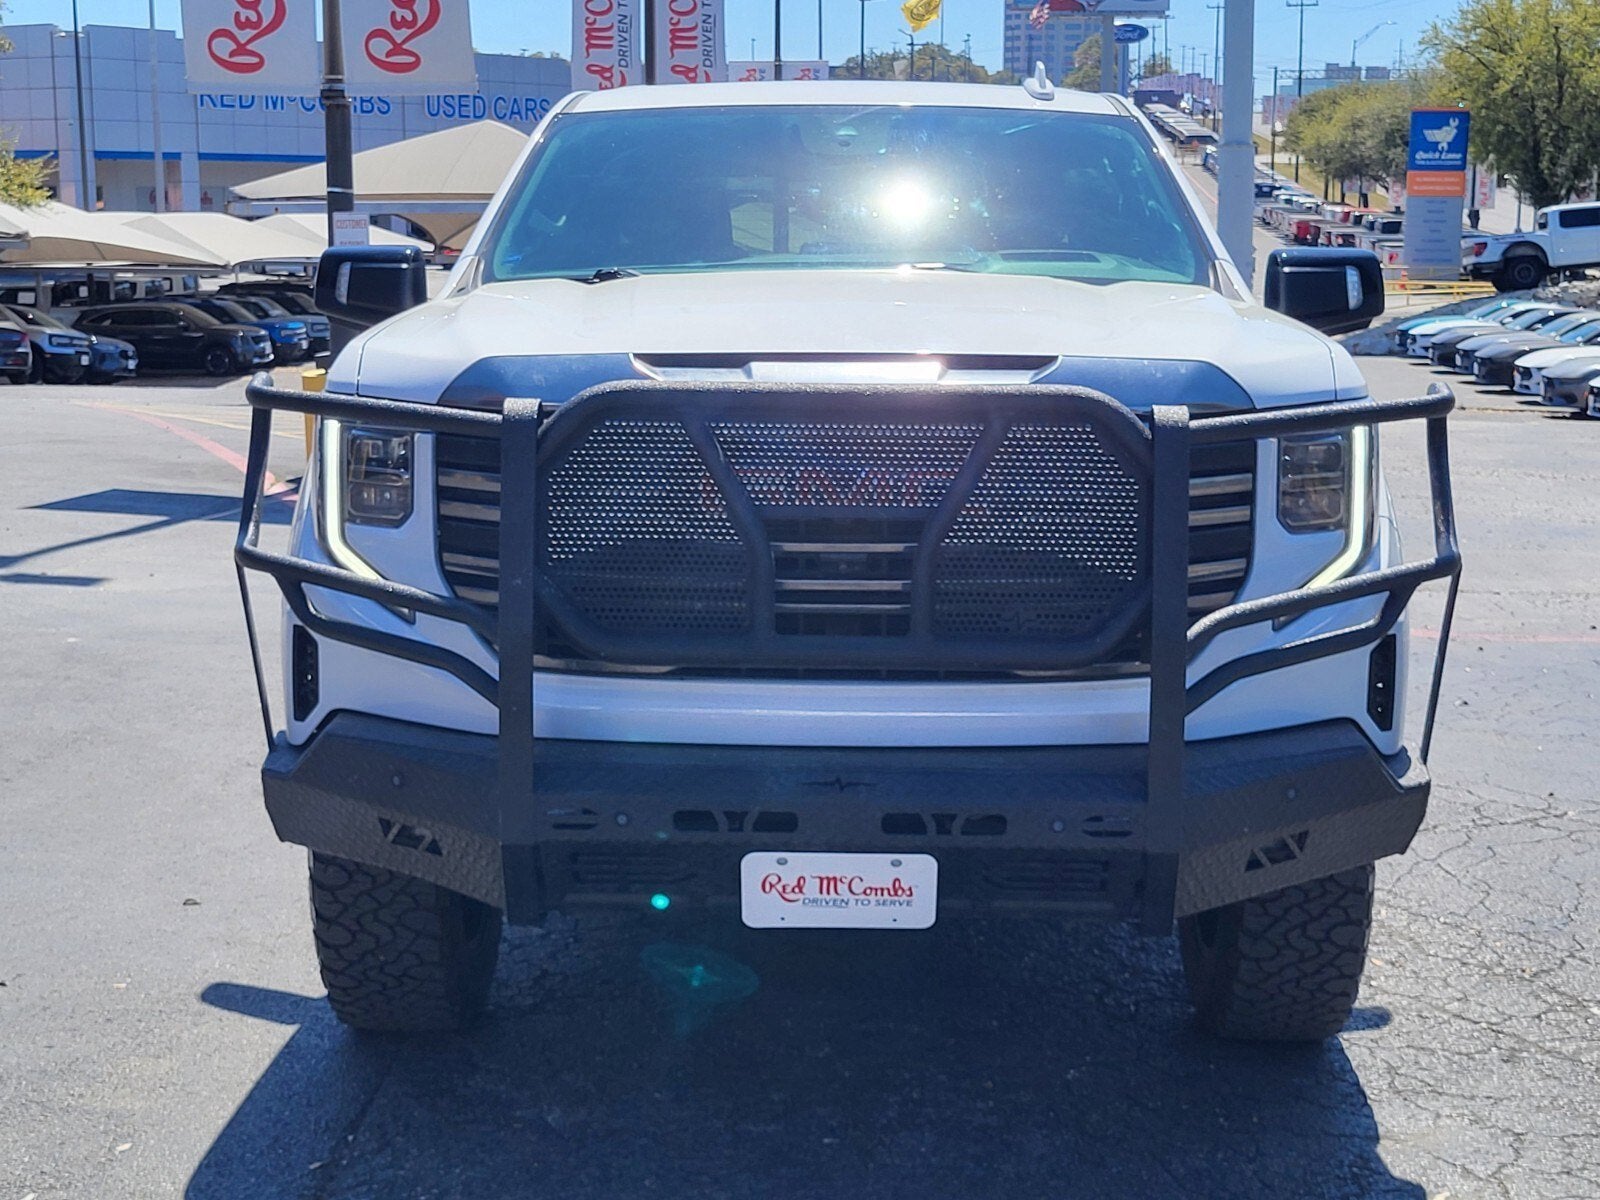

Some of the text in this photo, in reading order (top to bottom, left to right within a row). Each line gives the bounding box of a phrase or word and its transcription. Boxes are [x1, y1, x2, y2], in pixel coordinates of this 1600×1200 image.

[618, 14, 629, 69] DRIVEN
[701, 13, 713, 69] DRIVEN
[199, 94, 255, 109] RED
[426, 94, 486, 119] USED
[493, 96, 550, 121] CARS
[761, 873, 914, 902] Red McCombs
[802, 897, 913, 907] DRIVEN TO SERVE
